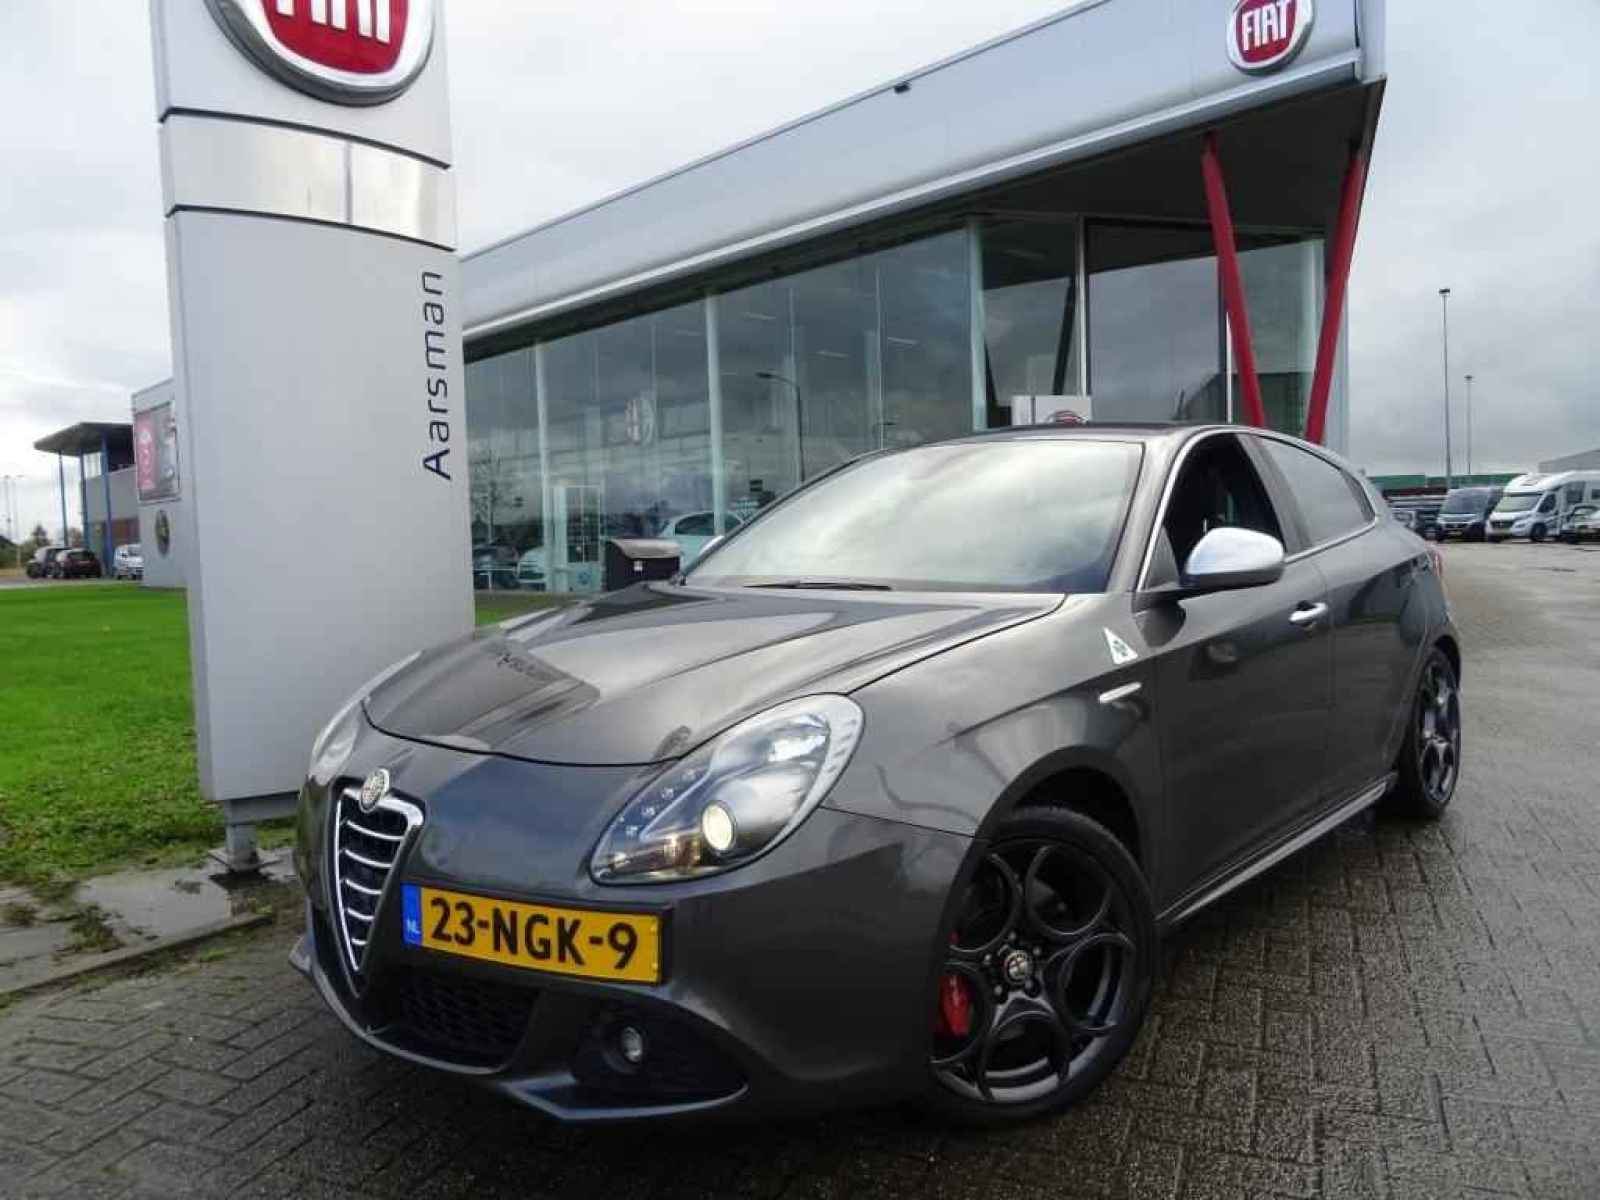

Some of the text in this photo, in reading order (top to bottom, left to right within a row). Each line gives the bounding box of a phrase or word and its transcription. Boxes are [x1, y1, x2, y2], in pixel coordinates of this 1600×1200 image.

[1242, 0, 1291, 51] FIAT
[422, 271, 451, 481] Aarsman
[430, 896, 638, 970] 23-NGK-9
